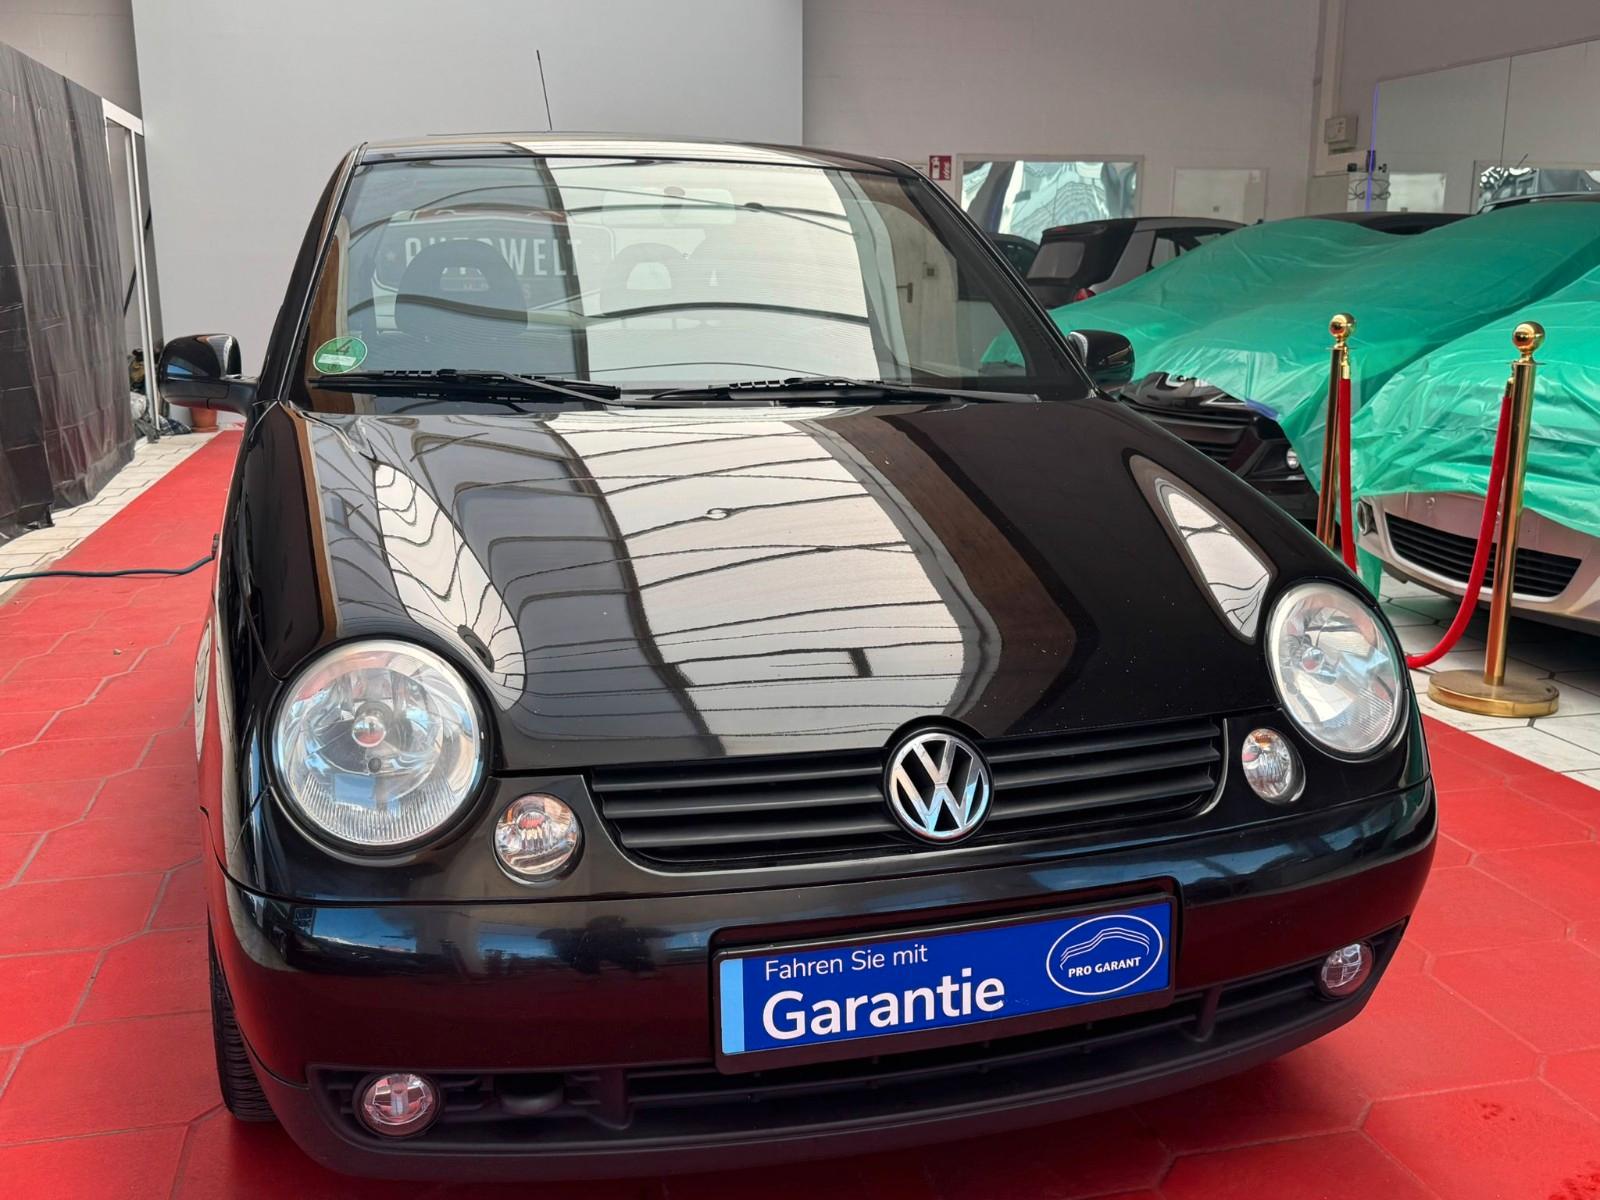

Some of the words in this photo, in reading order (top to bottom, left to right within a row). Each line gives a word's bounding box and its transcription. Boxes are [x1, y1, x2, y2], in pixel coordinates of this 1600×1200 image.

[888, 732, 990, 838] VW
[765, 957, 843, 982] Fahren
[851, 950, 886, 971] Sie
[893, 944, 929, 967] mit
[1068, 965, 1092, 978] PRO
[1095, 957, 1142, 973] GARANT
[762, 967, 1005, 1041] Garantie
